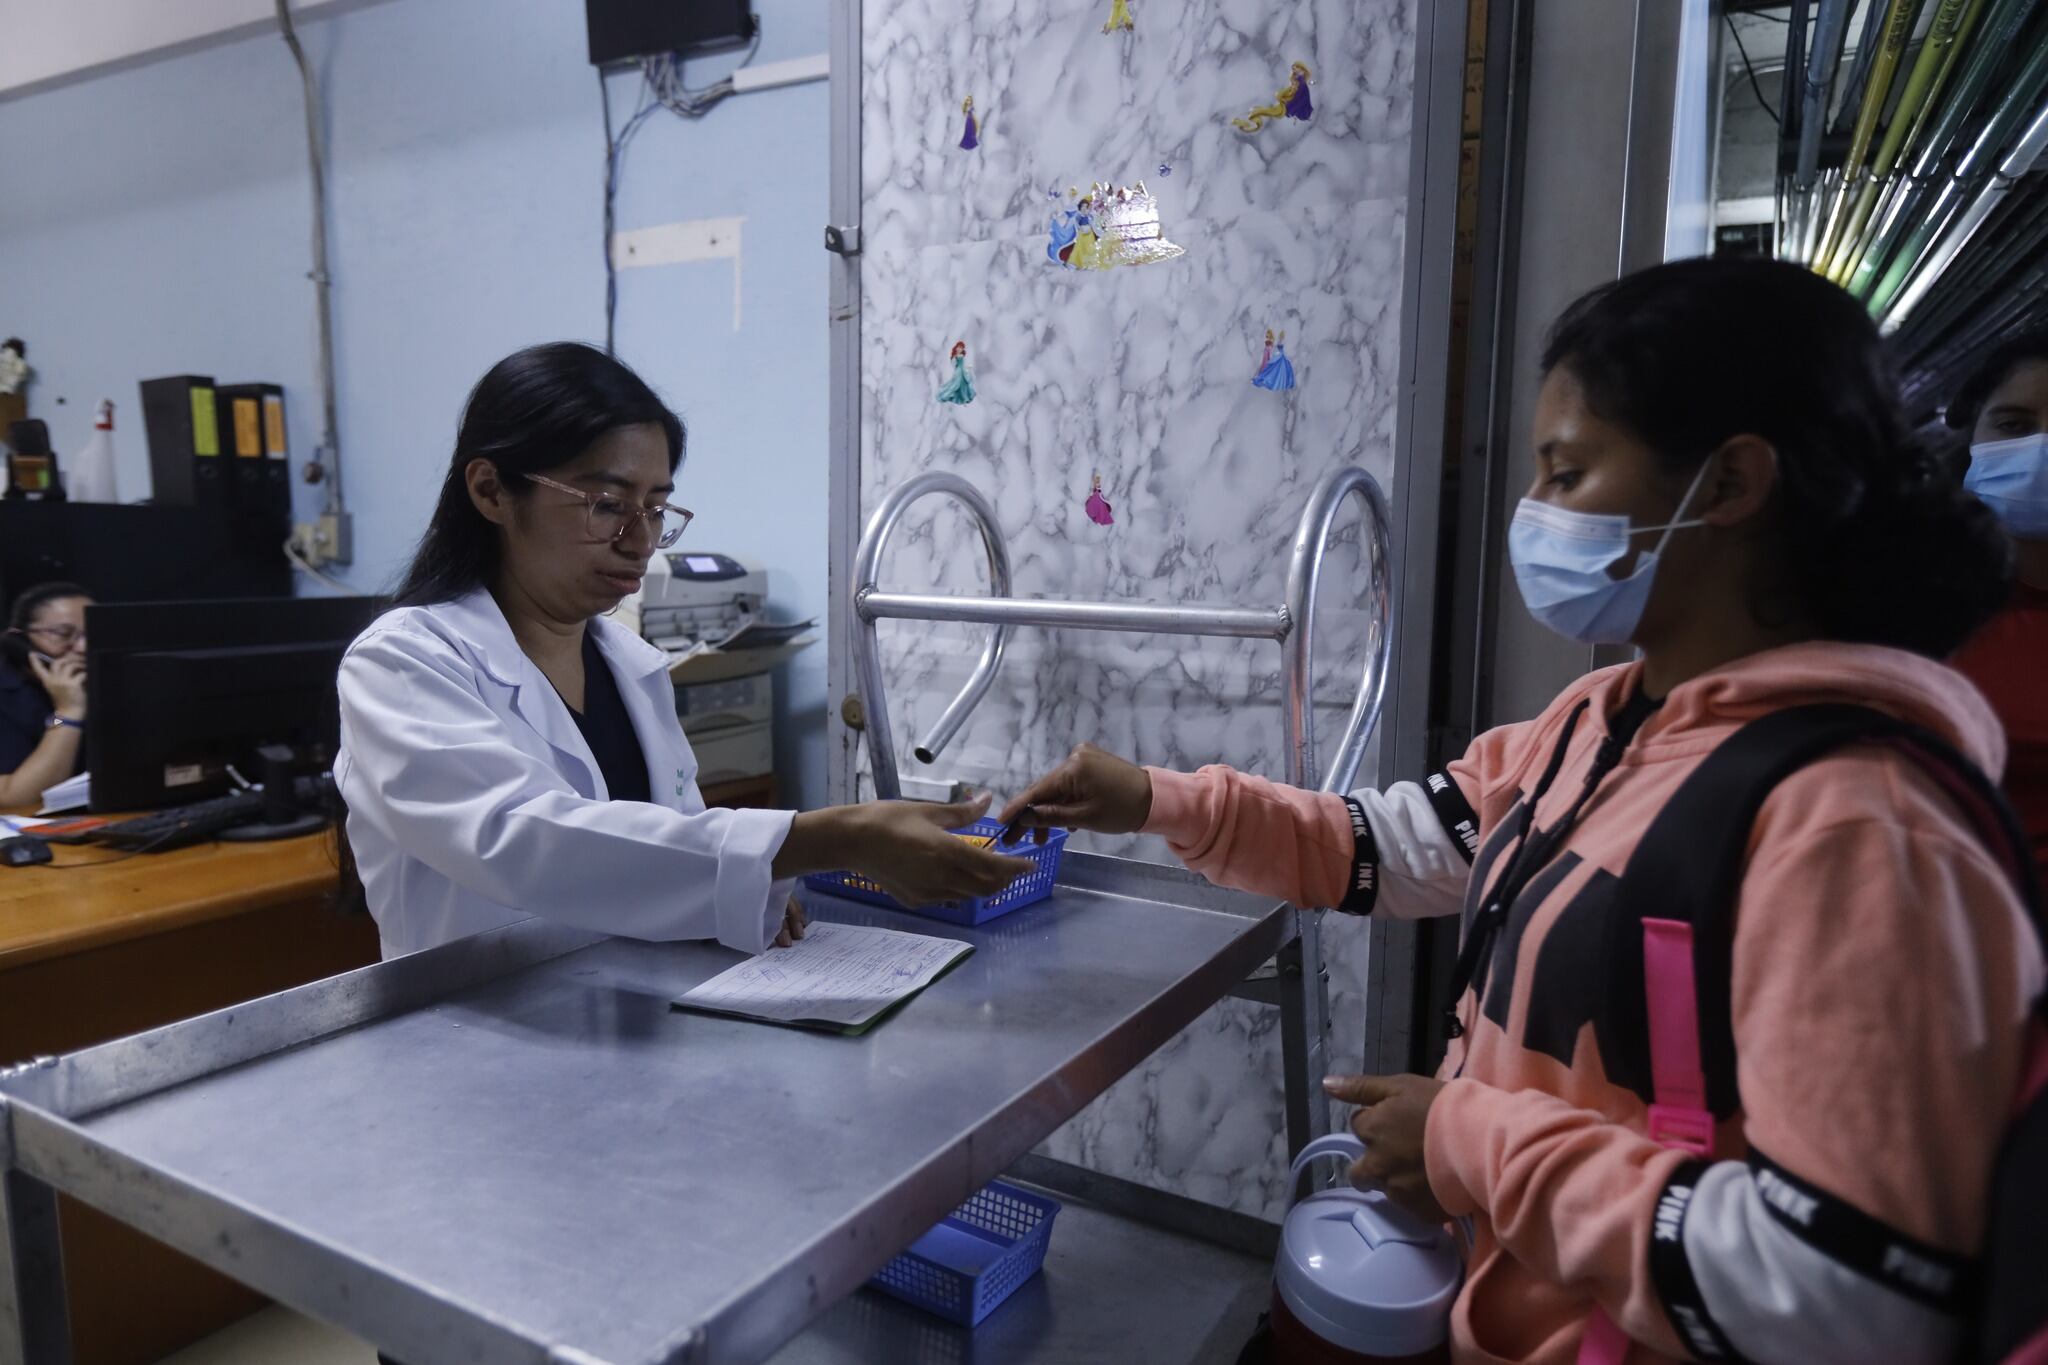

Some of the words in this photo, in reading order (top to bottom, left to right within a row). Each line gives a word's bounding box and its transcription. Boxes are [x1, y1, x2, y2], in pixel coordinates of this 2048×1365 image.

[1347, 803, 1367, 837] PINK
[1454, 820, 1479, 854] PIN
[1357, 862, 1373, 890] INK
[1655, 1185, 1692, 1241] PINK
